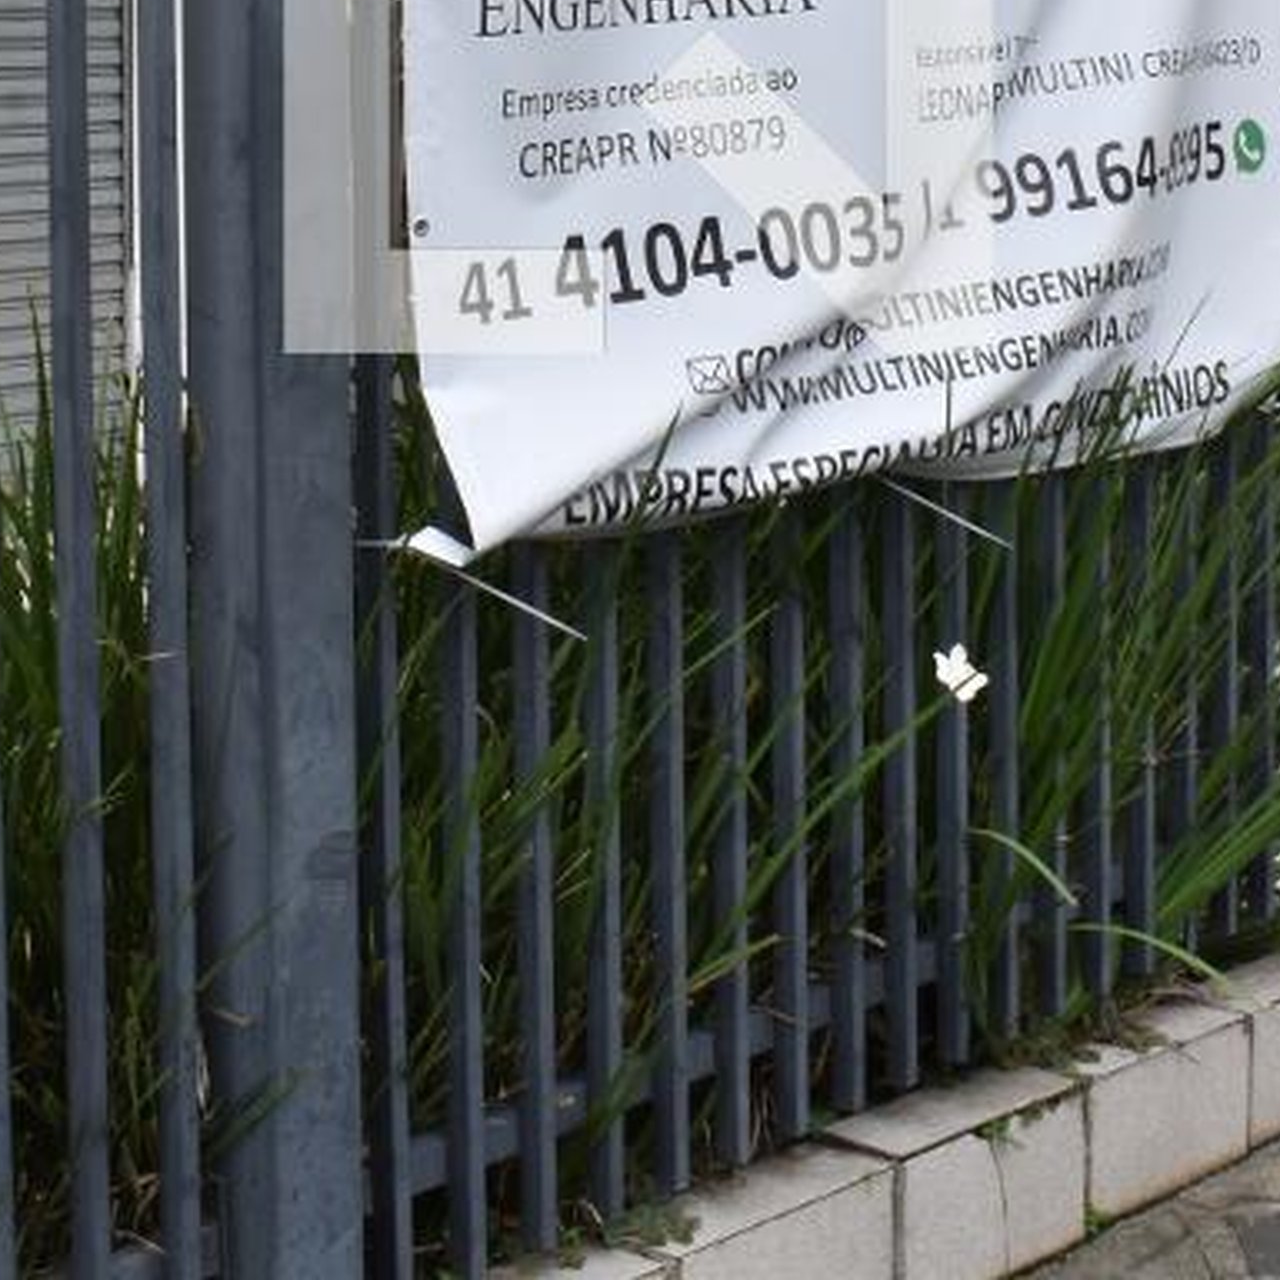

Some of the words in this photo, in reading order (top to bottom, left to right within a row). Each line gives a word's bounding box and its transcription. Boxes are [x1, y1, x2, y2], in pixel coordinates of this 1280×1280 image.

[501, 87, 599, 121] Empresa
[605, 67, 759, 108] credenciada
[765, 67, 798, 92] ao
[519, 132, 639, 179] CREAPR
[458, 256, 533, 325] 41
[554, 192, 906, 309] 4104-0035
